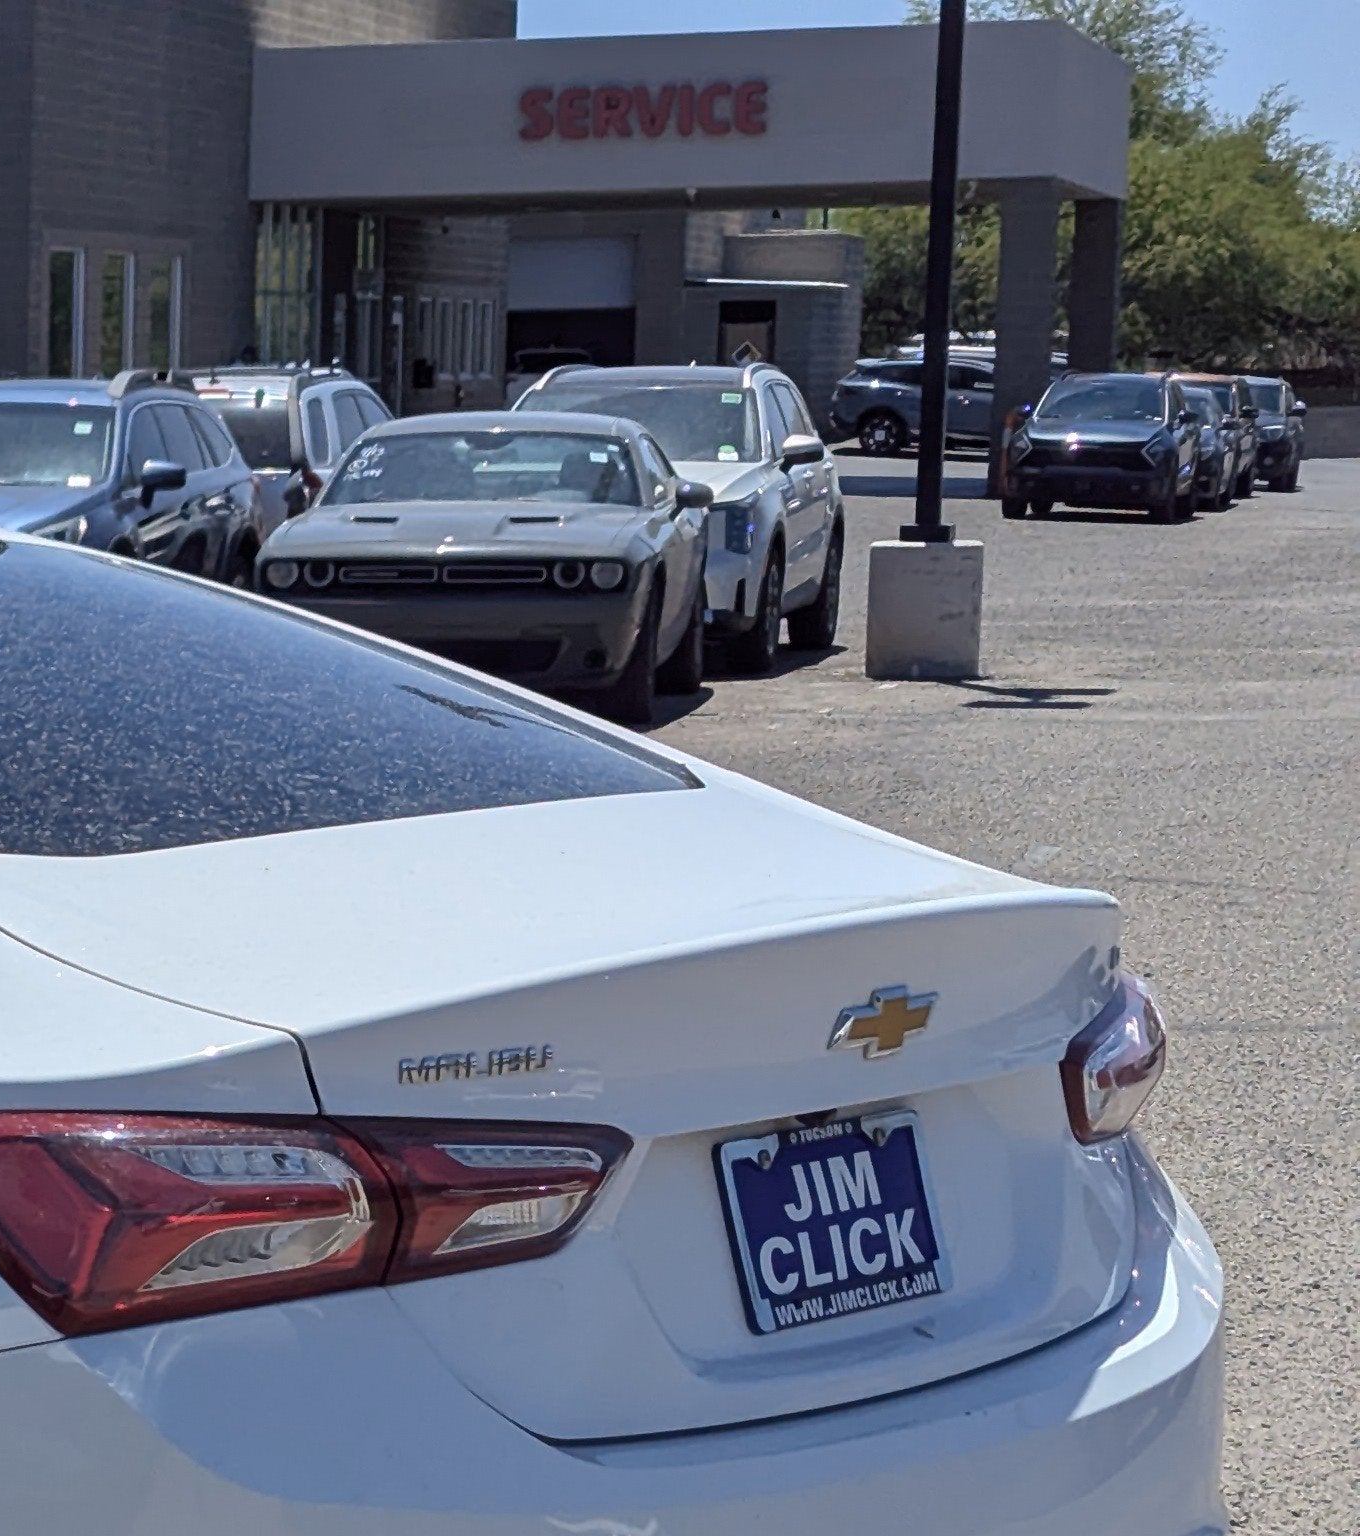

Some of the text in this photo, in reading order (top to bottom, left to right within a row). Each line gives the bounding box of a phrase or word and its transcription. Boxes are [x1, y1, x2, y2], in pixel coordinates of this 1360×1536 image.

[518, 80, 769, 141] SERVICE
[398, 1044, 555, 1085] MALIBU
[784, 1150, 882, 1222] JIM
[759, 1208, 926, 1295] CLICK
[775, 1270, 938, 1327] WWW.JIMCLICK.COM
